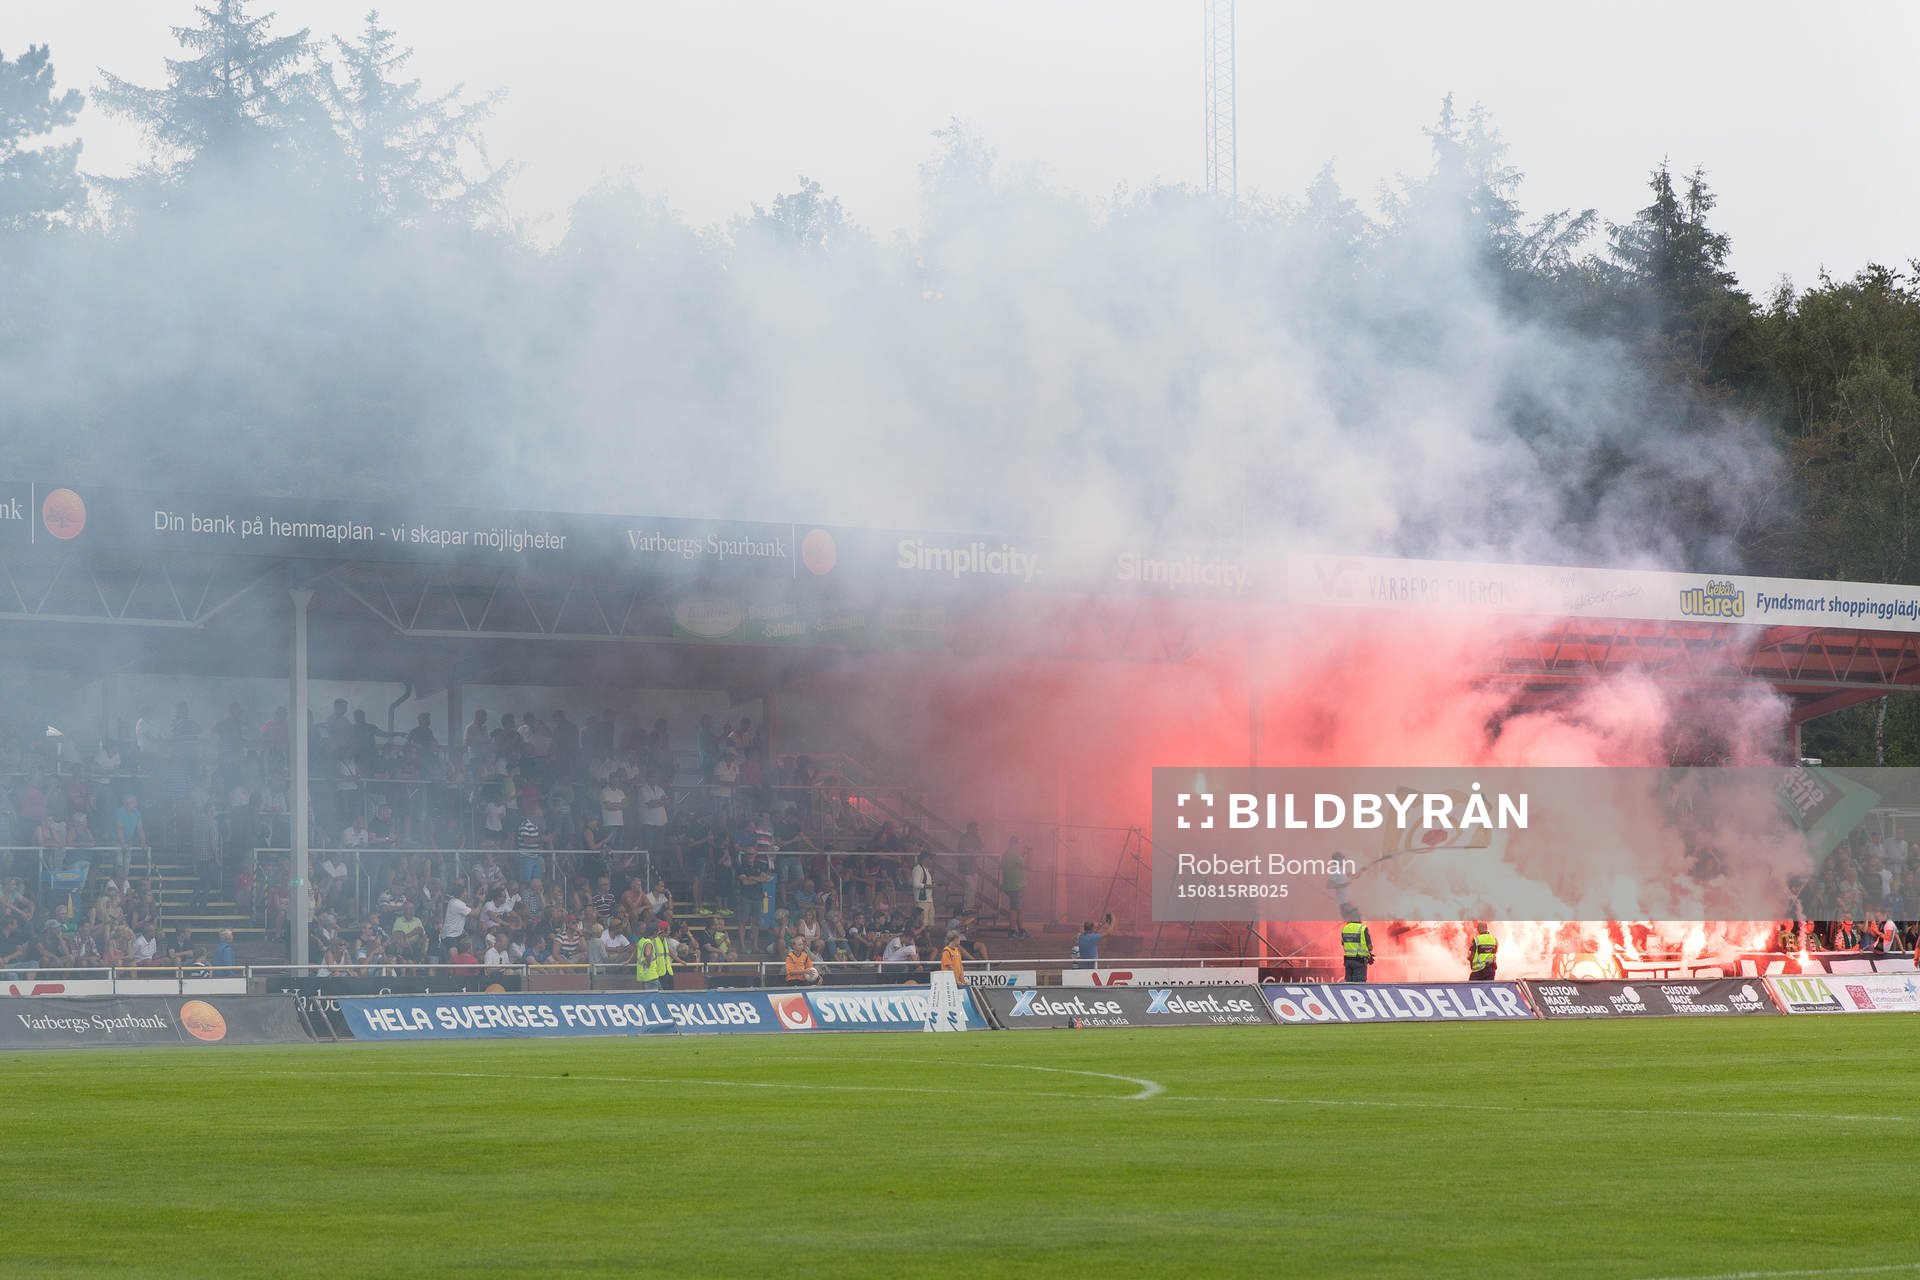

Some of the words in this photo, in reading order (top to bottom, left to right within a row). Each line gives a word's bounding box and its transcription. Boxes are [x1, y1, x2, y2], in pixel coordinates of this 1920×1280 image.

[154, 511, 185, 531] Din
[191, 513, 236, 534] bank
[242, 516, 264, 539] på
[270, 517, 374, 543] hemmaplan
[391, 523, 405, 543] vi
[410, 525, 469, 548] skapar
[473, 528, 567, 552] möjligheter
[627, 530, 702, 560] Varbergs
[707, 534, 786, 560] Sparbank
[898, 539, 1043, 583] Simplicity.
[1680, 588, 1745, 617] Ullared
[1756, 593, 1825, 613] Fyndsmart
[1539, 986, 1580, 996] CUSTOM
[1543, 996, 1573, 1005] MADE
[1660, 986, 1701, 995] CUSTOM
[1666, 995, 1693, 1004] MADE
[1776, 978, 1834, 1003] MTA
[816, 995, 969, 1023] STRYKTIP
[1009, 990, 1123, 1016] Xelent.se
[1146, 989, 1255, 1014] Xelent.se
[1340, 987, 1529, 1019] BILDELAR
[1549, 1005, 1609, 1014] PAPERBOARD
[1614, 1003, 1647, 1013] paper
[1671, 1004, 1729, 1013] PAPERBOARD
[1733, 1002, 1765, 1012] paper
[17, 1014, 90, 1033] Varbergs
[91, 1013, 168, 1033] Sparbank
[364, 1007, 434, 1031] HELA
[436, 1005, 558, 1030] SVERIGES
[559, 1002, 761, 1027] FOTBOLLSKLUBB
[1093, 1017, 1108, 1026] din
[1111, 1016, 1129, 1025] sida
[1209, 1015, 1226, 1023] Vid
